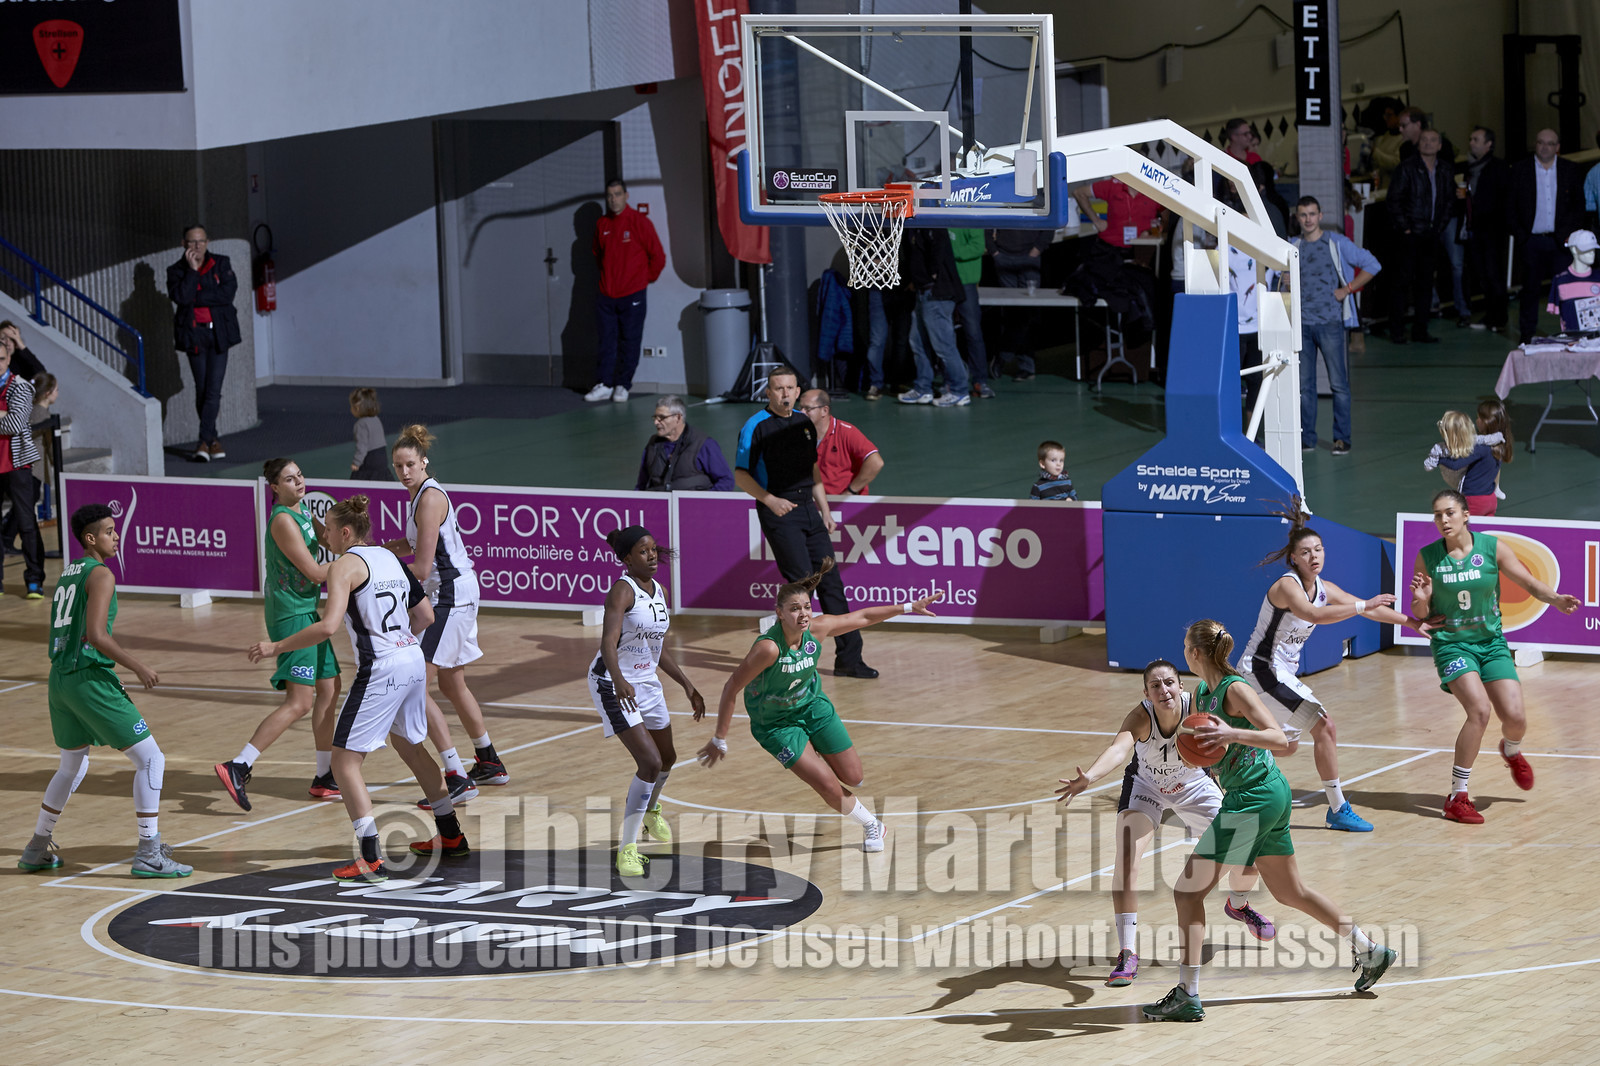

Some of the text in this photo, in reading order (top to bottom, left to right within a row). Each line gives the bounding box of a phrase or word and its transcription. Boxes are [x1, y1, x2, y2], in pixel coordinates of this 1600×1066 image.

[790, 172, 836, 183] EuroCup
[1140, 162, 1169, 186] MARTY
[1137, 464, 1251, 480] Schelde Sports
[1138, 482, 1148, 492] by
[1149, 483, 1216, 501] MARTY
[494, 504, 560, 538] FOR
[135, 525, 227, 549] UFAB49
[136, 547, 155, 555] UNION
[182, 549, 205, 557] ANGERS
[205, 550, 228, 558] BASKET
[487, 543, 574, 561] immobilière
[578, 546, 589, 562] à
[593, 547, 624, 567] Ang
[1443, 573, 1457, 584] UNI
[53, 583, 77, 629] 22
[1457, 589, 1472, 611] 9
[648, 602, 668, 623] 13
[782, 663, 796, 674] UNI
